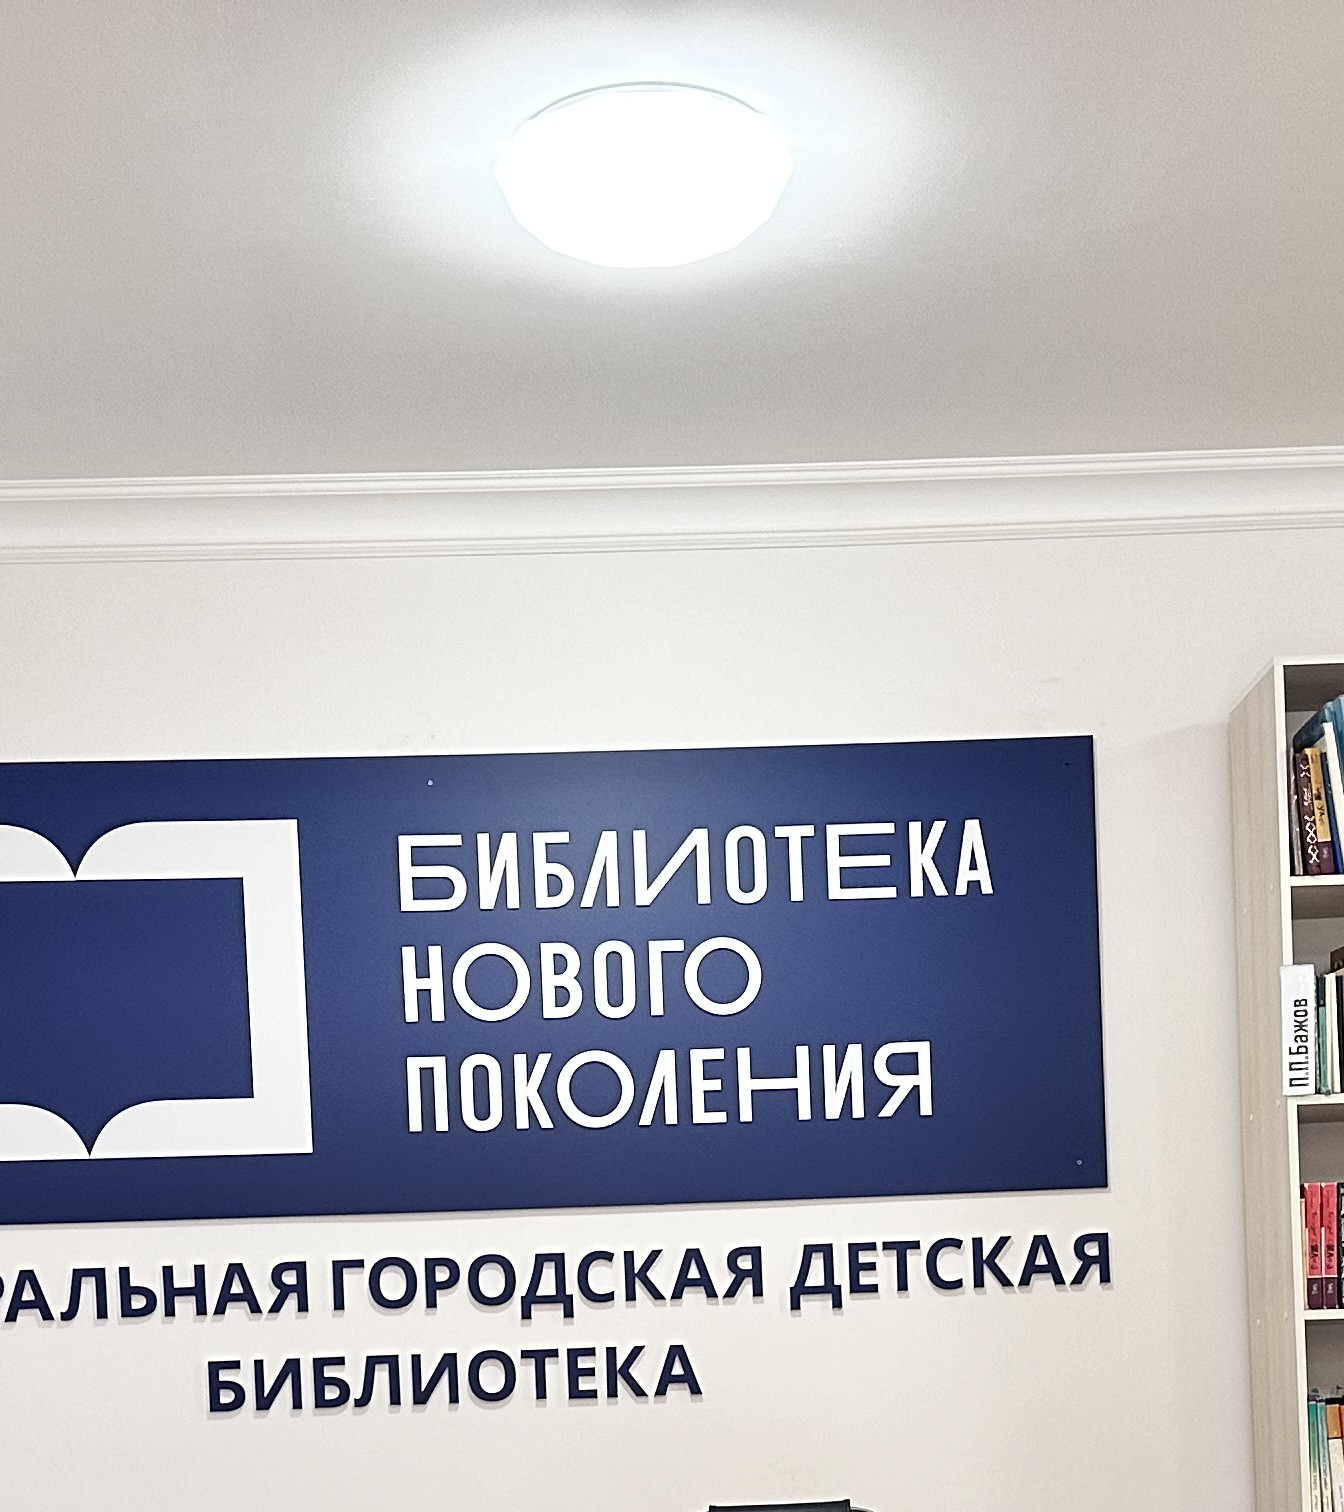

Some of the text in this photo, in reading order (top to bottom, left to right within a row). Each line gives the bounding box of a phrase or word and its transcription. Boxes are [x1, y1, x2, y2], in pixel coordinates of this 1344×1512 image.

[397, 818, 995, 914] БИБЛИОТЕКА
[402, 934, 763, 1024] НОВОГО
[406, 1040, 935, 1134] ПОКОЛЕНИЯ
[1288, 997, 1309, 1087] П.П.Бажов
[330, 1246, 765, 1318] ГОРОДСКАЯ
[789, 1232, 1113, 1311] ДЕТСКАЯ
[208, 1343, 703, 1414] БИБЛИОТЕКА
